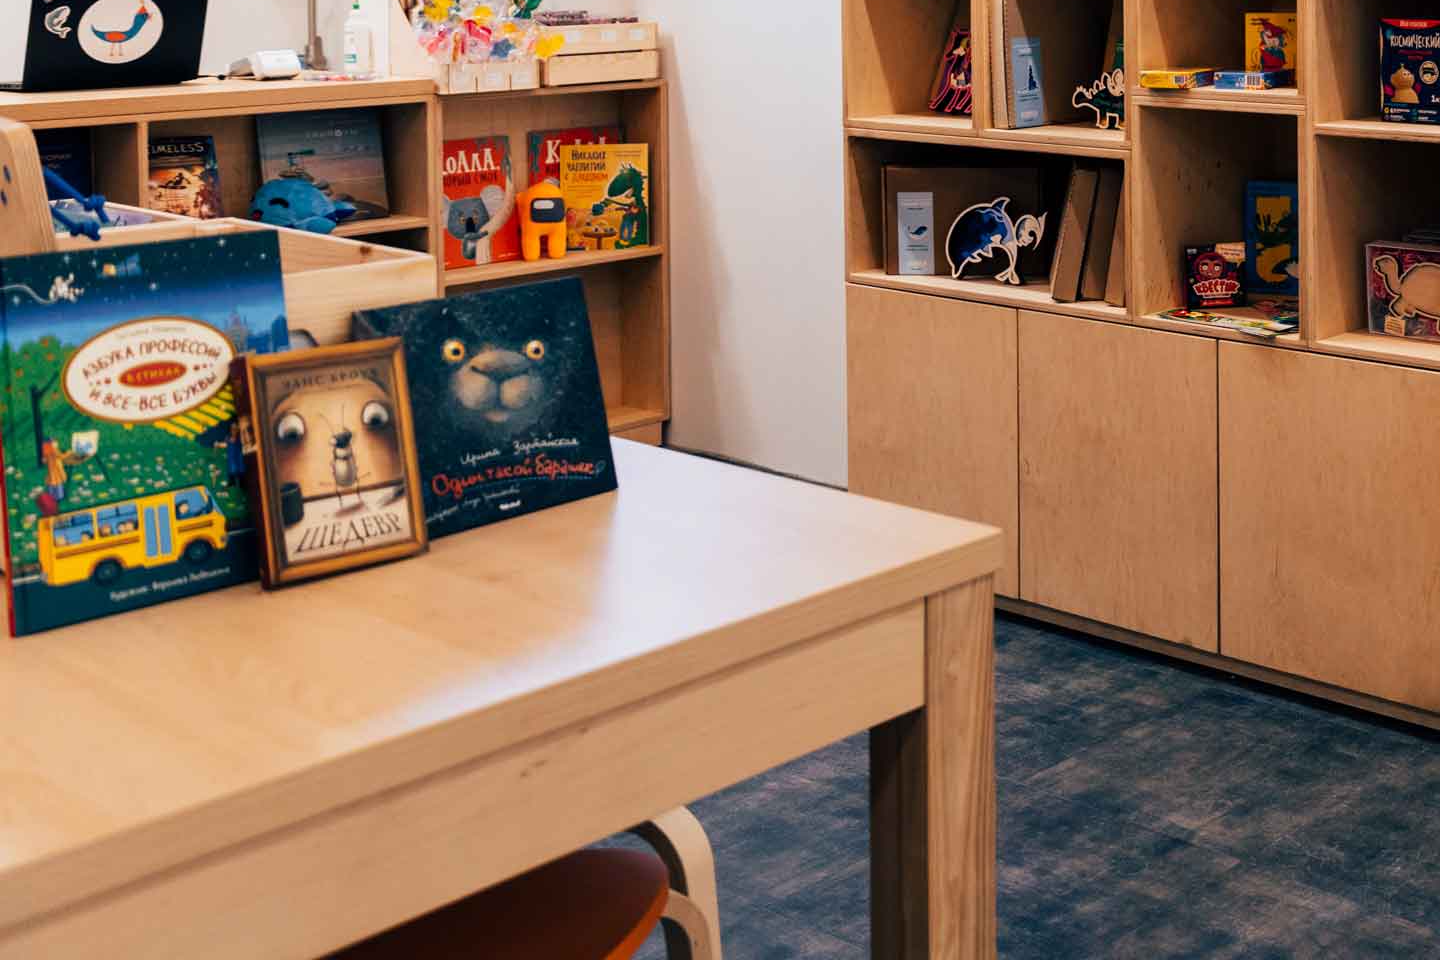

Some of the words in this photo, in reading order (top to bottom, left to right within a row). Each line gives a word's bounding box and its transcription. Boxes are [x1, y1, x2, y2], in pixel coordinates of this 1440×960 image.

[1390, 32, 1440, 49] КОСМИЧЕСКИЙ
[147, 141, 206, 154] IMELESS
[82, 345, 135, 379] АЗБУКА
[139, 338, 222, 361] ПРОФЕССИЙ
[89, 388, 101, 401] И
[172, 371, 218, 405] БУКВЫ
[295, 512, 402, 553] ШЕДЕВР
